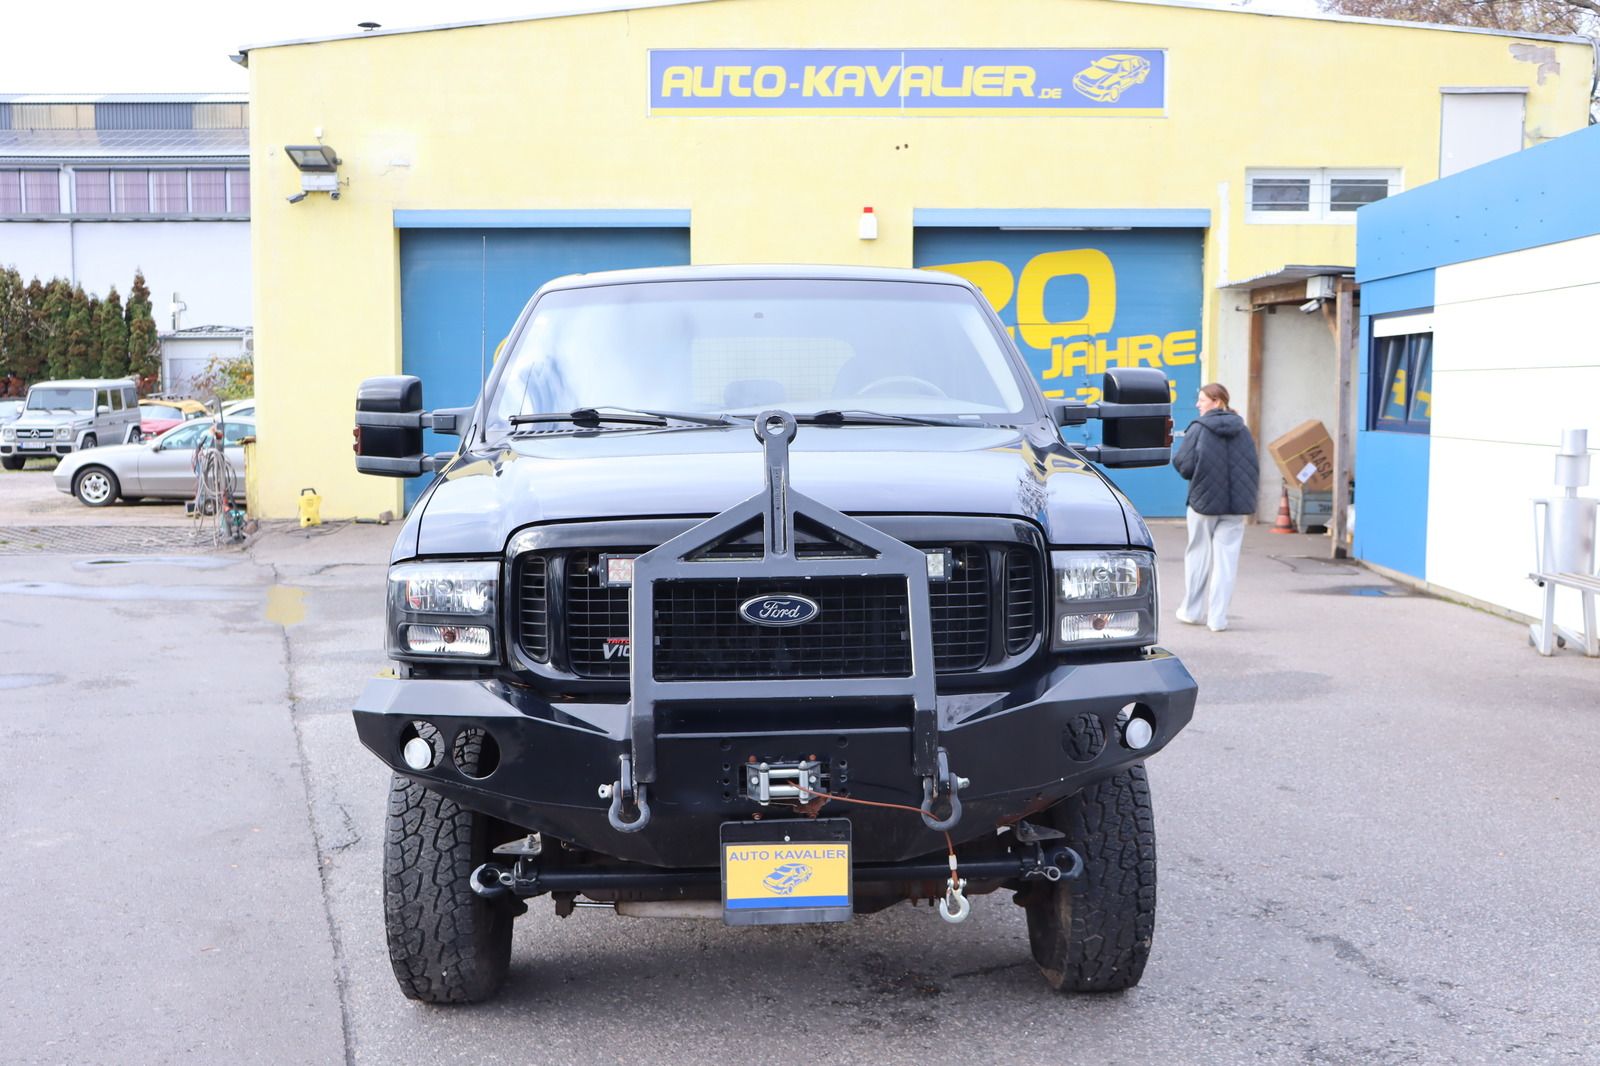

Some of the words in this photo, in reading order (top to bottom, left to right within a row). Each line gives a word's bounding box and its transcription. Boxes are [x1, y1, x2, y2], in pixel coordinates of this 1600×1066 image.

[1042, 329, 1196, 380] JAHRE
[759, 600, 800, 618] Ford
[729, 850, 770, 861] AUTO
[774, 849, 847, 860] KAVALIER
